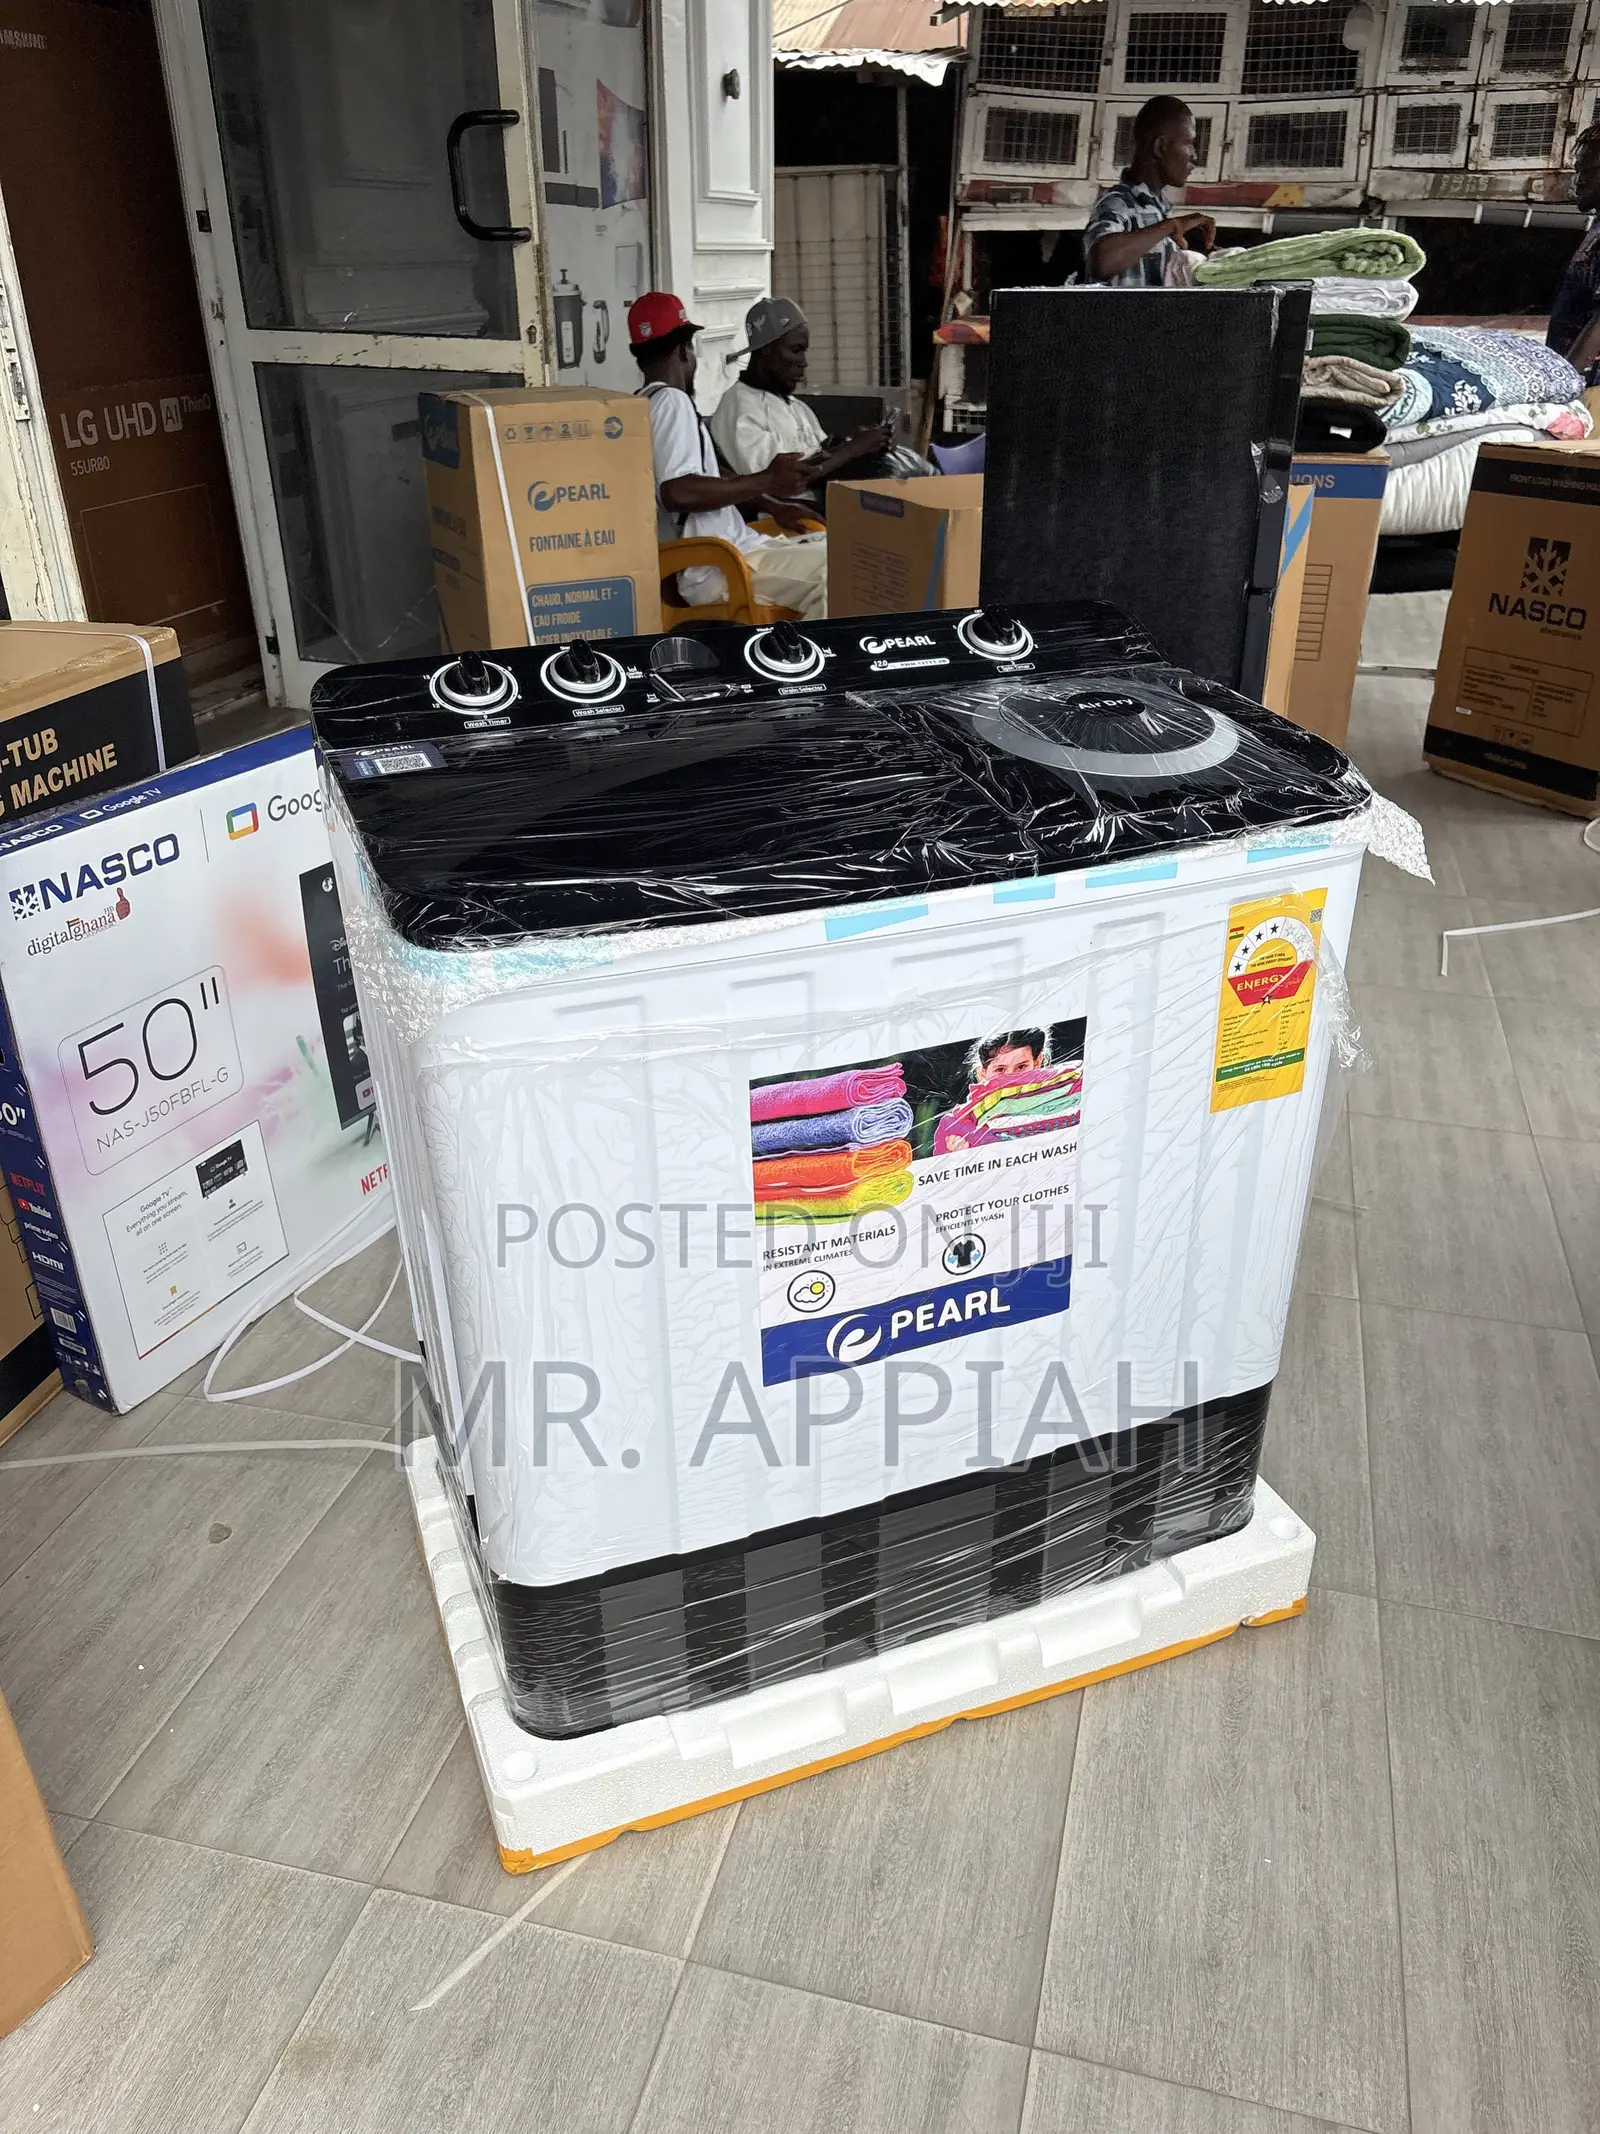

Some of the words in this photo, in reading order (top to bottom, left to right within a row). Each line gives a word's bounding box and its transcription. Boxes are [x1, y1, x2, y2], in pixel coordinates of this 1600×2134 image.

[60, 409, 99, 449] LG
[104, 402, 157, 441] UHD
[70, 456, 111, 476] 55UR80
[556, 484, 610, 503] PEARL
[530, 532, 582, 552] FONTAINE
[584, 528, 591, 548] À
[595, 529, 615, 547] EAU
[532, 592, 564, 608] CHAUD,
[565, 588, 601, 604] NORMAL
[602, 588, 612, 601] ET
[534, 613, 550, 627] EAU
[552, 611, 581, 626] FROIDE
[1488, 592, 1587, 630] NASCO
[884, 635, 936, 649] PEARL
[596, 706, 621, 714] Selector
[467, 720, 487, 728] Wash
[0, 728, 58, 773] -TUB
[10, 743, 118, 809] MACHINE
[102, 793, 147, 812] Google
[143, 787, 162, 799] TV
[38, 833, 180, 910] NASCO
[78, 976, 220, 1115] 50"
[0, 1102, 26, 1126] 0"
[96, 1067, 229, 1153] NAS-J50FBFL-G
[918, 1170, 950, 1187] SAVE
[954, 1162, 985, 1178] TIME
[988, 1158, 1001, 1170] IN
[1005, 1152, 1038, 1168] EACH
[1041, 1142, 1078, 1159] WASH
[9, 1172, 46, 1197] NETFLIX
[140, 1196, 162, 1213] Google
[936, 1203, 985, 1223] PROTECT
[987, 1197, 1020, 1210] YOUR
[1023, 1184, 1070, 1203] CLOTHES
[126, 1210, 156, 1232] Everything
[156, 1203, 167, 1214] you
[143, 1223, 151, 1232] on
[151, 1216, 162, 1226] one
[935, 1218, 980, 1234] EFFICIENTLY
[980, 1212, 1005, 1222] WASH
[24, 1221, 41, 1234] prime
[41, 1227, 59, 1240] video
[763, 1240, 828, 1261] RESISTANT
[830, 1225, 896, 1248] MATERIALS
[32, 1251, 65, 1271] HDMI
[763, 1264, 772, 1272] IN
[774, 1257, 812, 1270] EXTREME
[814, 1249, 854, 1263] CLIMATES
[890, 1286, 1011, 1340] PEARL
